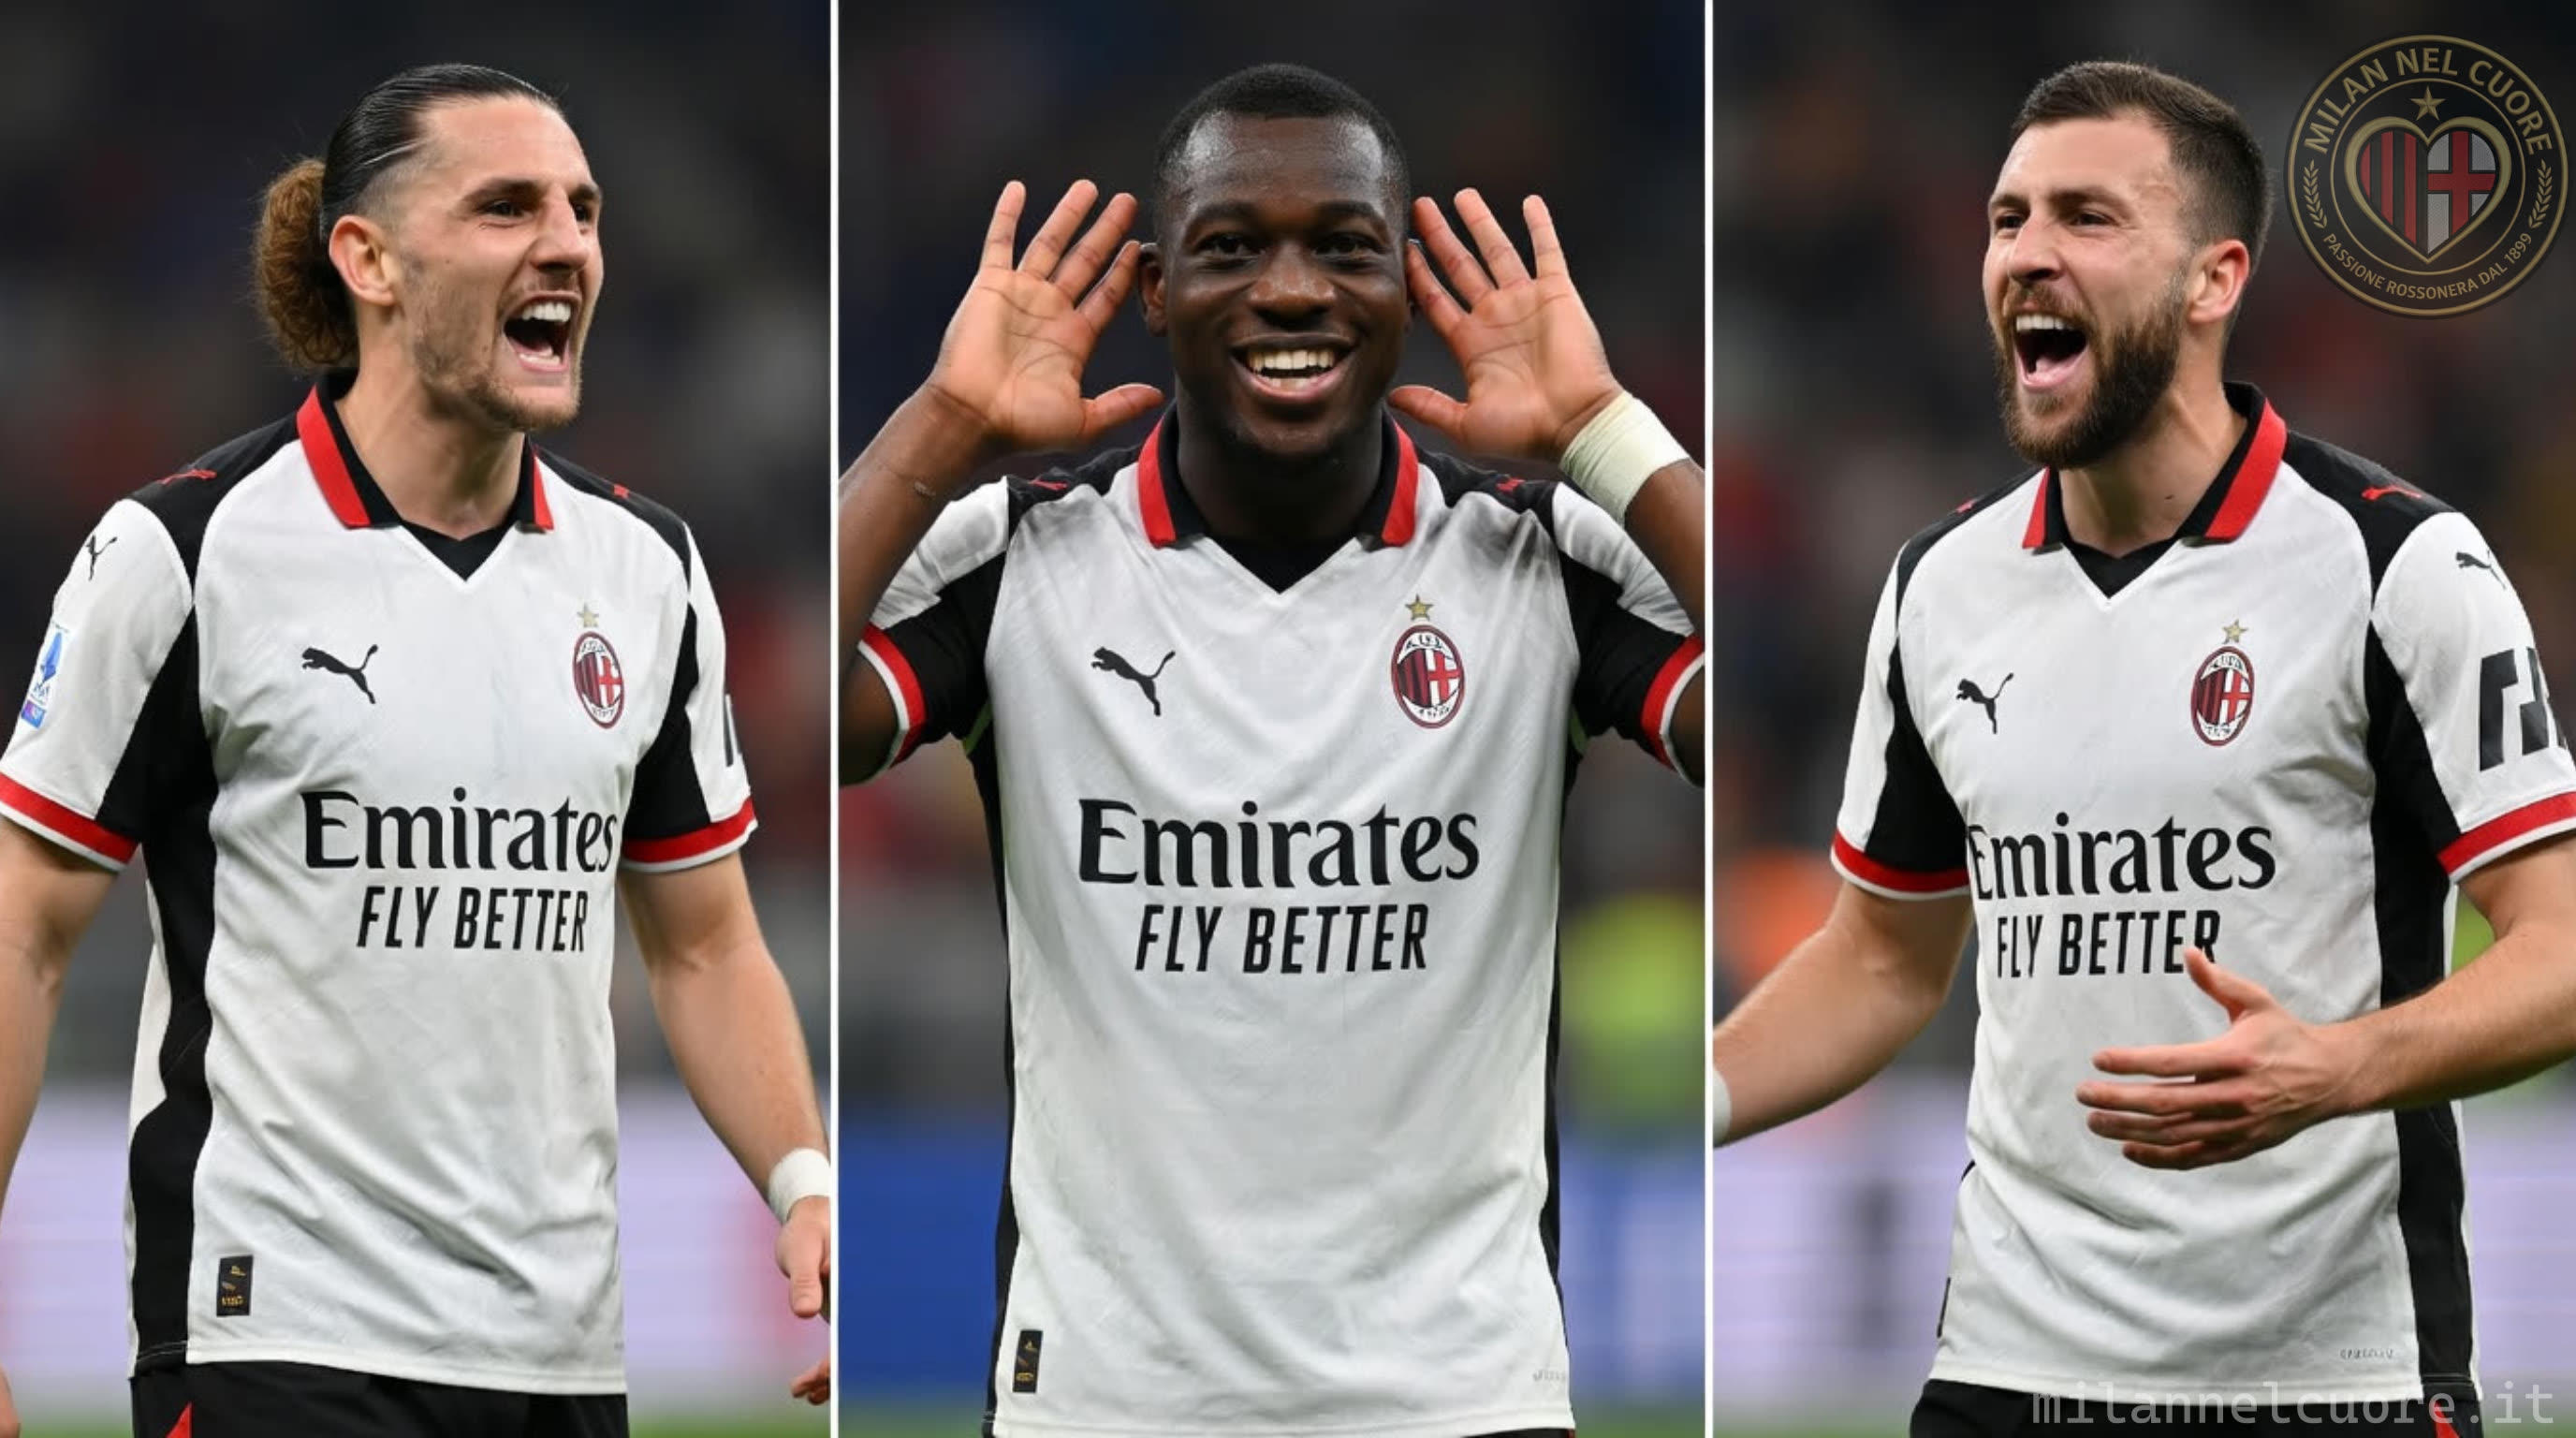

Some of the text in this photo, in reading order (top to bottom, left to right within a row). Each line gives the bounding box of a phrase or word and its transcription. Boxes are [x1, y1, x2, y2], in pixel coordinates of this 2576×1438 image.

[300, 786, 617, 872] Emirates
[1079, 800, 1479, 888] Emirates
[1969, 812, 2275, 901] Emirates
[357, 886, 588, 951] FLY BETTER
[1135, 903, 1428, 974] FLY BETTER
[1998, 909, 2220, 977] FLY BETTER
